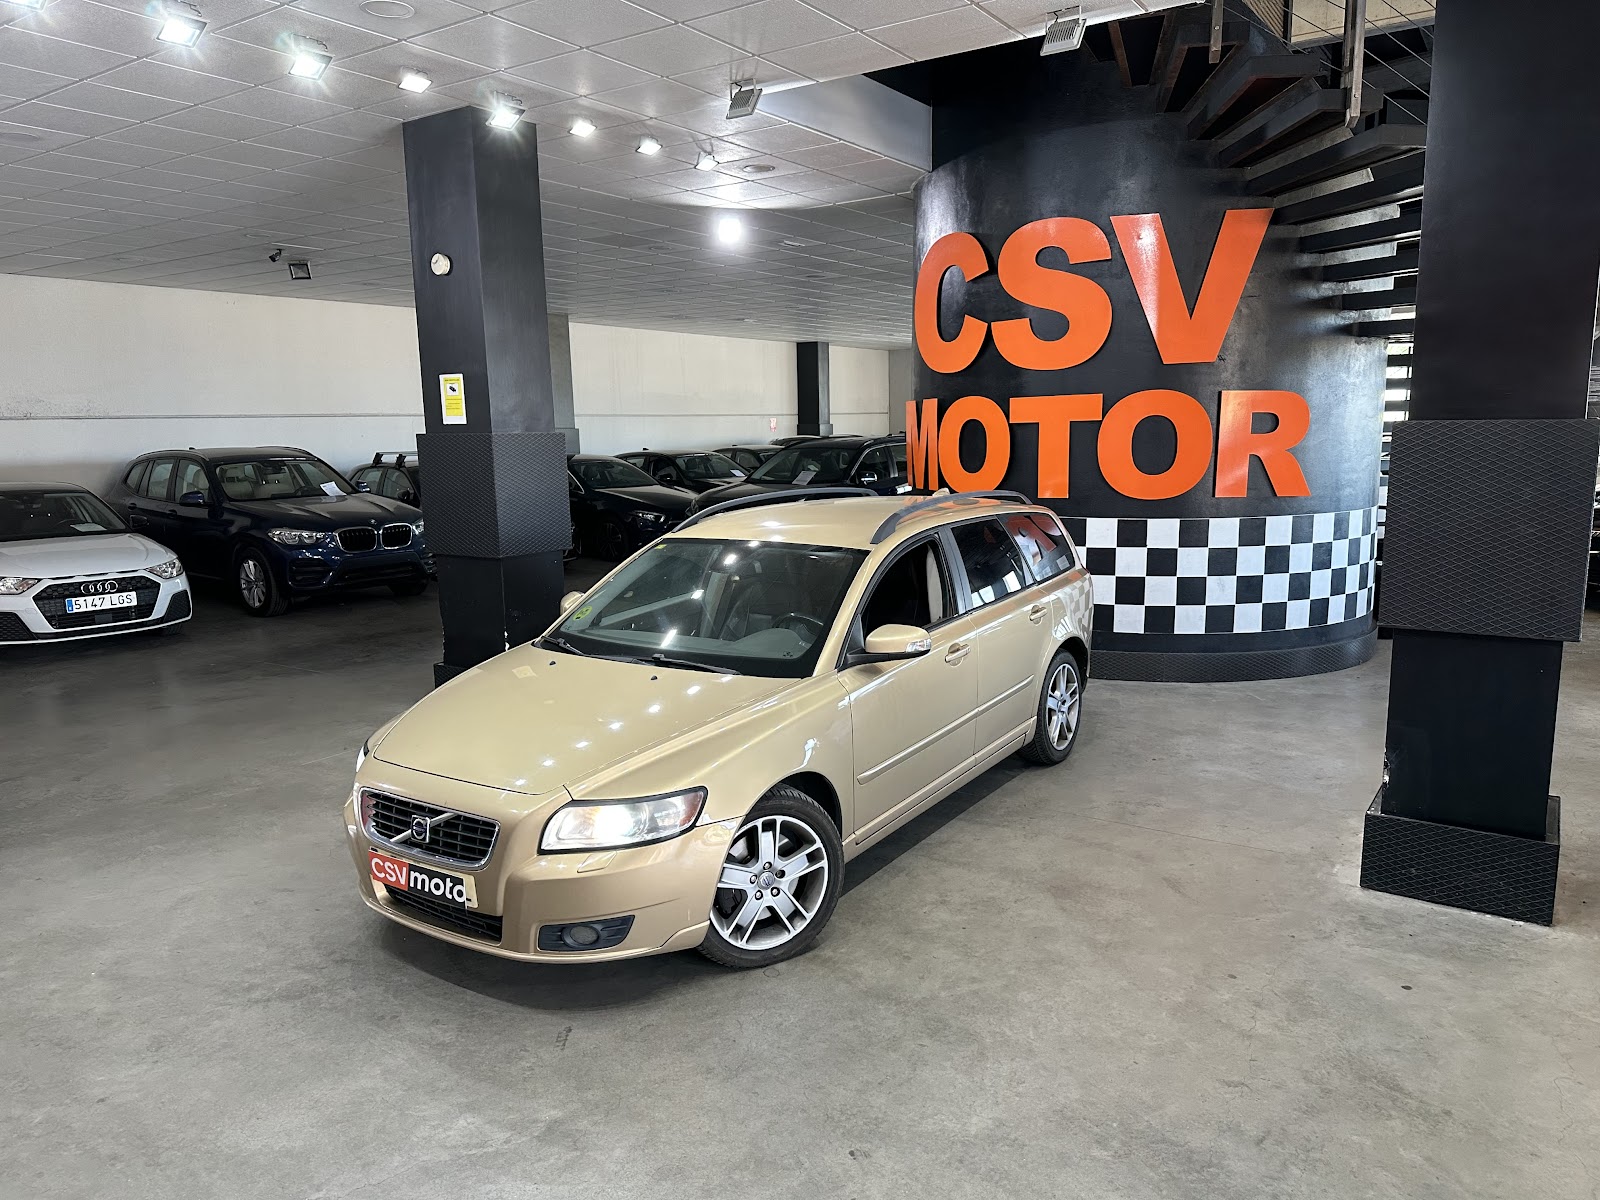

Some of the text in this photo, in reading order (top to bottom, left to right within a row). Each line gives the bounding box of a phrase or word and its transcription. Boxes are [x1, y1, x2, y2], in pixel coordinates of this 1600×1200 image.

[914, 208, 1275, 373] CSV
[906, 389, 1311, 500] MOTOR
[74, 594, 133, 610] 5147 LGS
